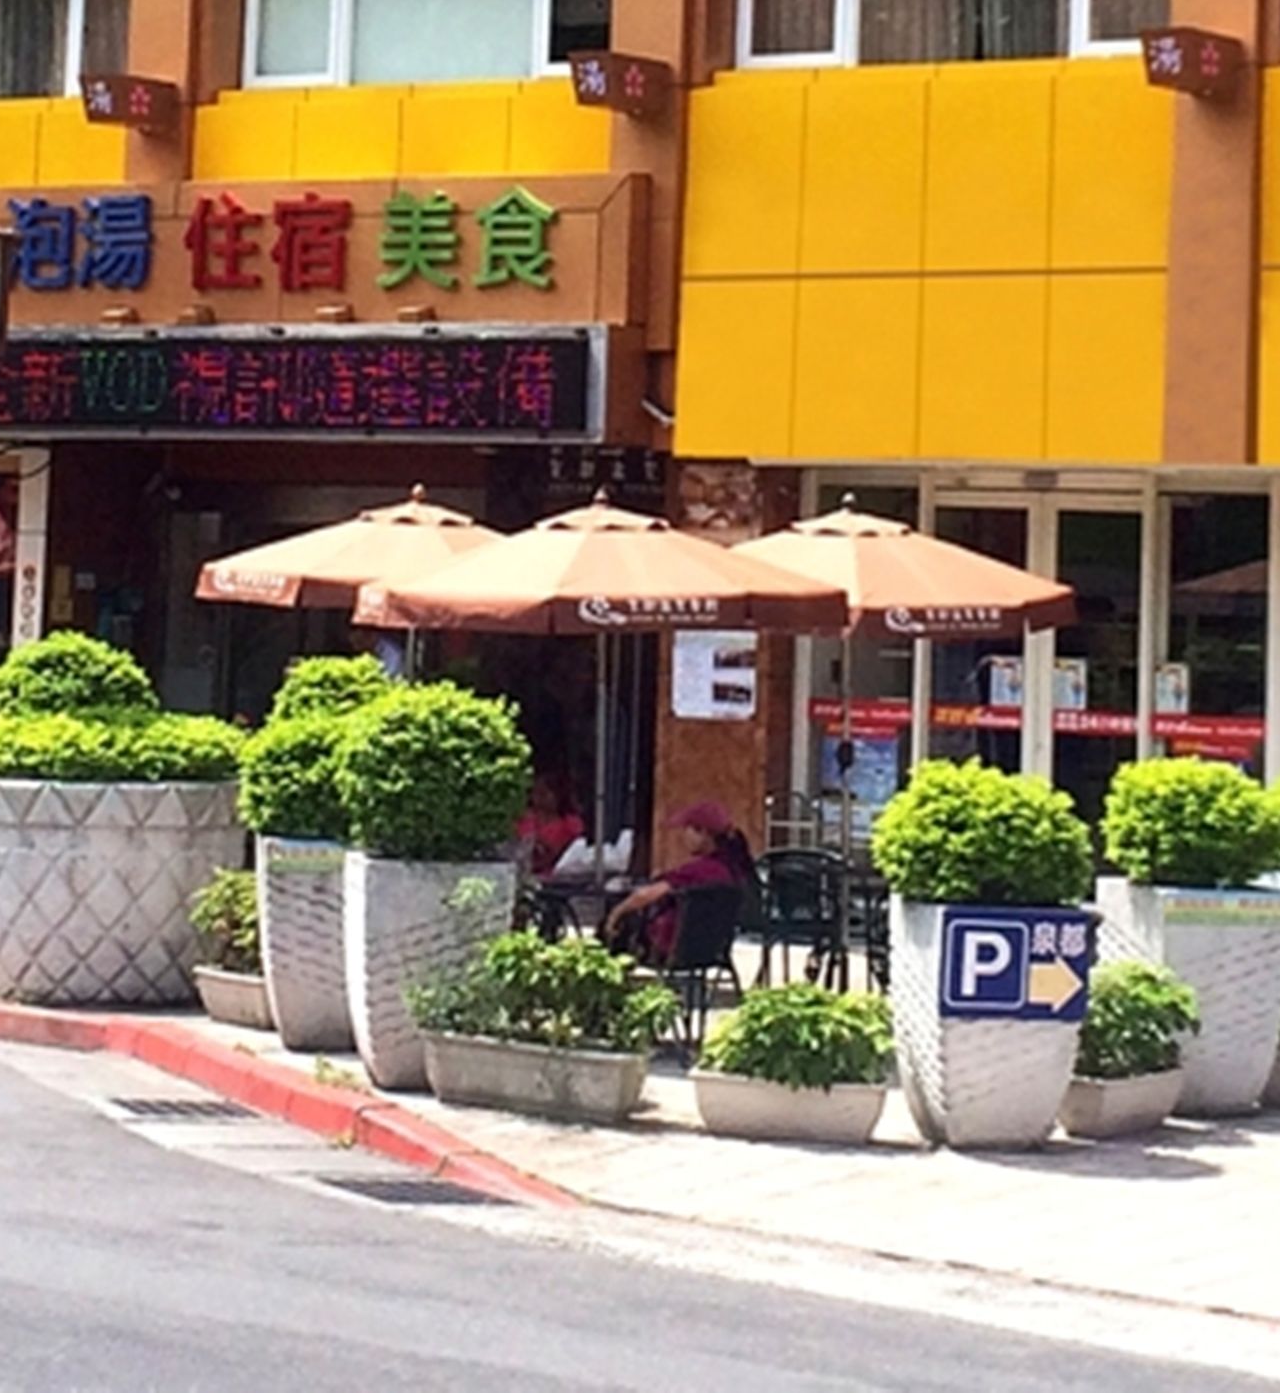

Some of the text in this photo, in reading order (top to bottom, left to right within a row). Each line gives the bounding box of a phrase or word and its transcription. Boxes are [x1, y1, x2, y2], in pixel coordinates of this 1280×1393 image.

[6, 185, 558, 292] 泡湯 住宿 美食
[961, 930, 1012, 997] P
